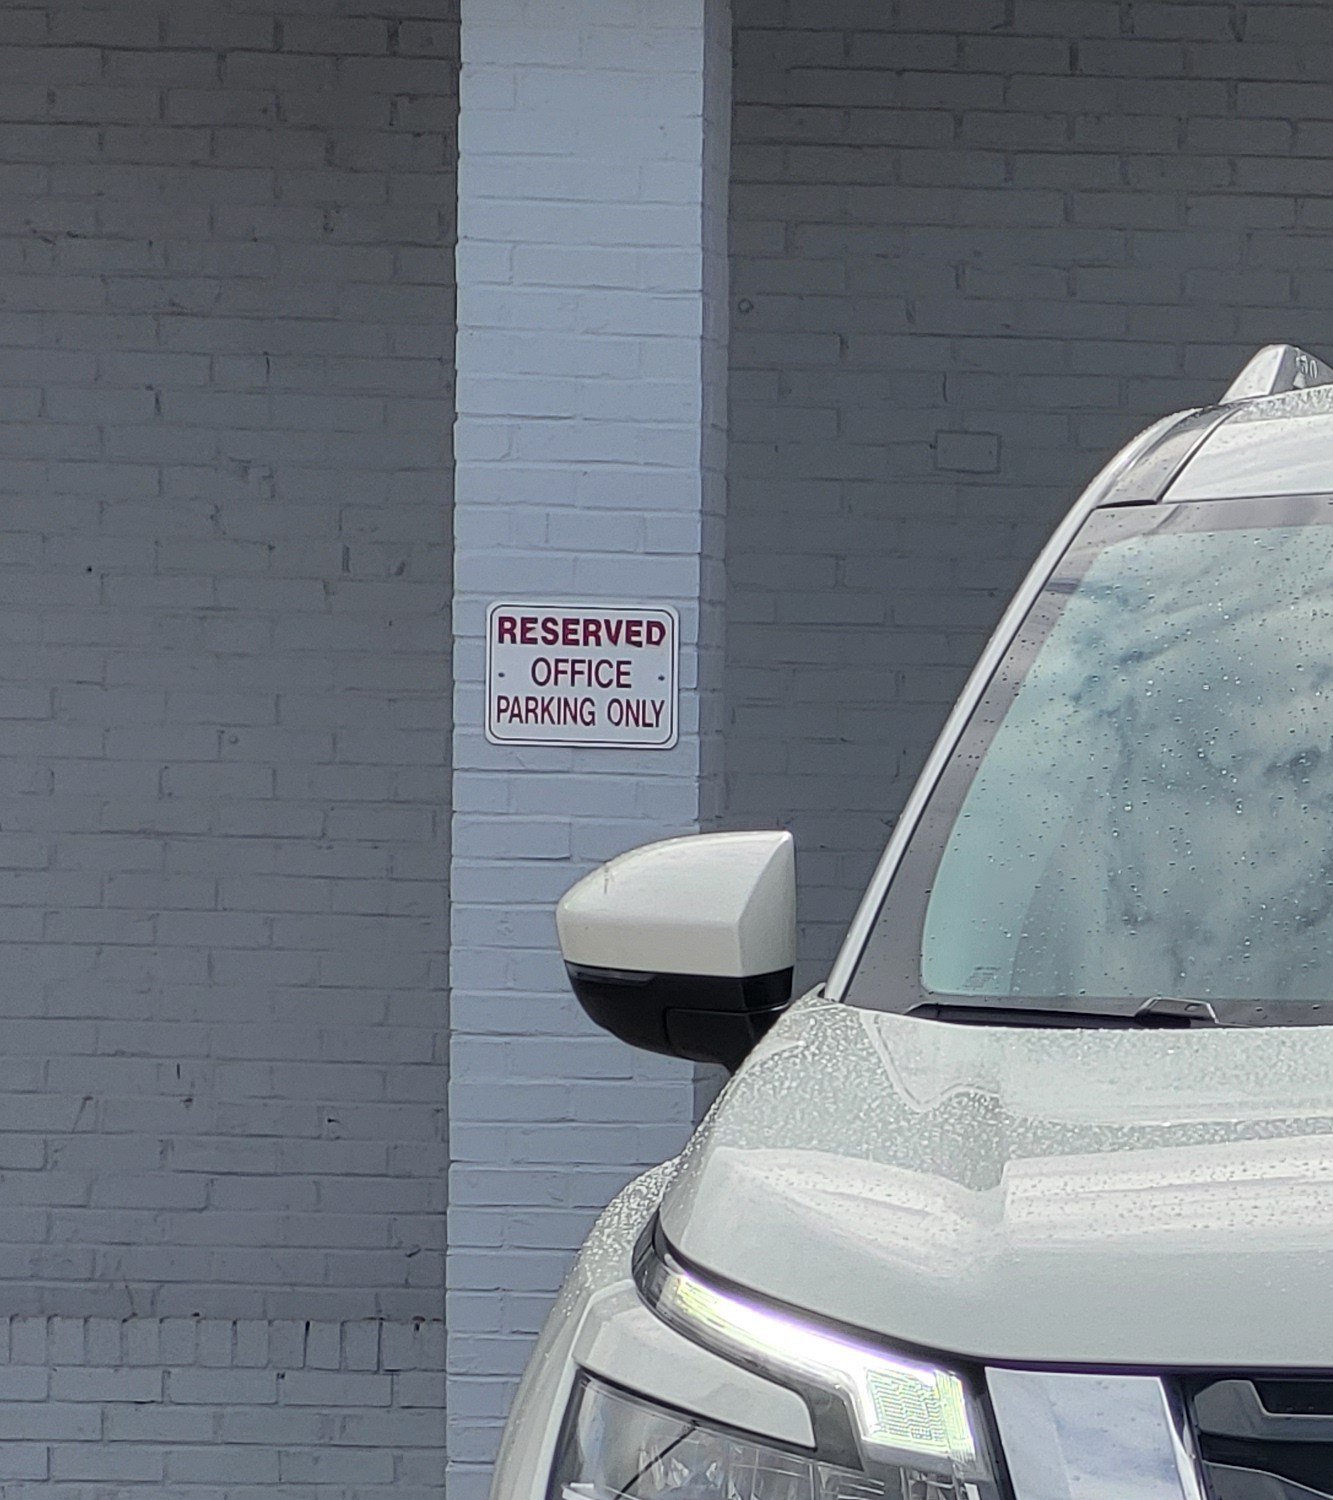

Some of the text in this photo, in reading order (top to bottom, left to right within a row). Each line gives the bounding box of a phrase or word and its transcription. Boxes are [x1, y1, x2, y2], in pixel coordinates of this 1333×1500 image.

[498, 616, 666, 648] RESERVED
[531, 657, 632, 689] OFFICE
[497, 695, 665, 728] PARKING ONLY
